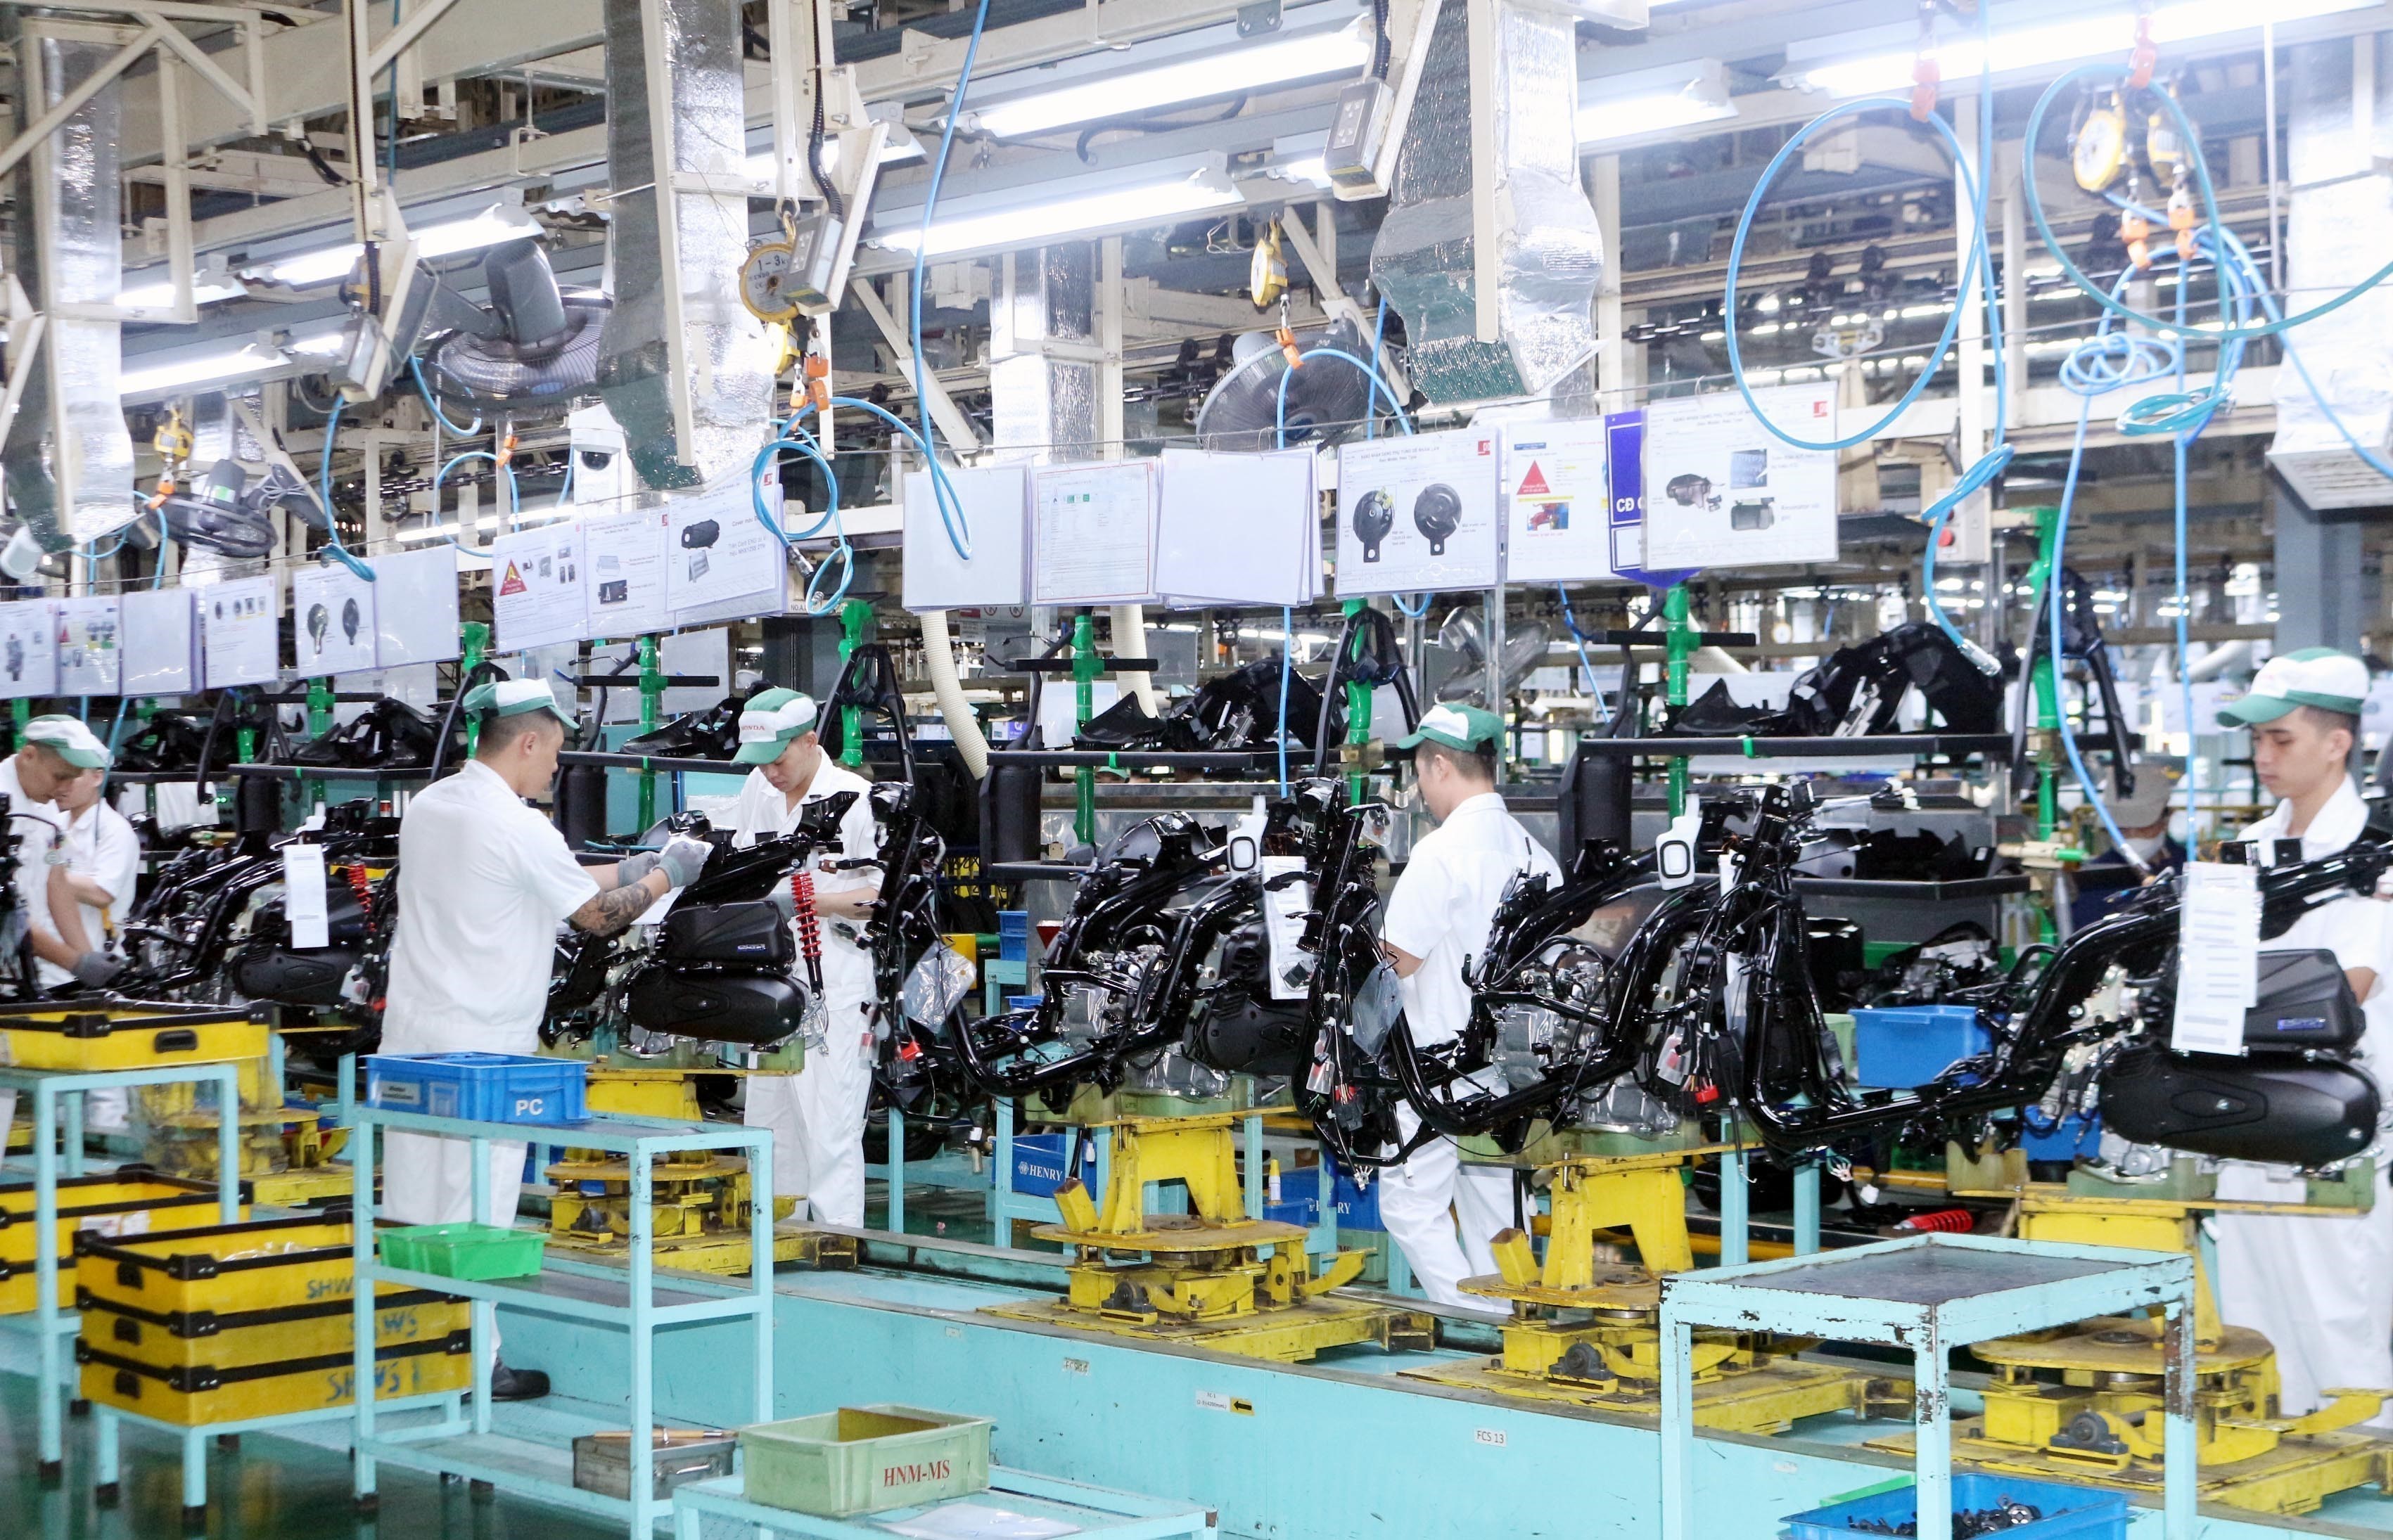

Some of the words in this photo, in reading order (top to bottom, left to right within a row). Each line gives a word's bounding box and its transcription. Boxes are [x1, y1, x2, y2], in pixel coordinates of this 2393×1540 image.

[516, 1098, 544, 1117] PC
[1029, 1164, 1063, 1181] HENRY
[1476, 1430, 1492, 1442] FCS
[1495, 1433, 1504, 1444] 13
[883, 1459, 950, 1487] HNM-MS
